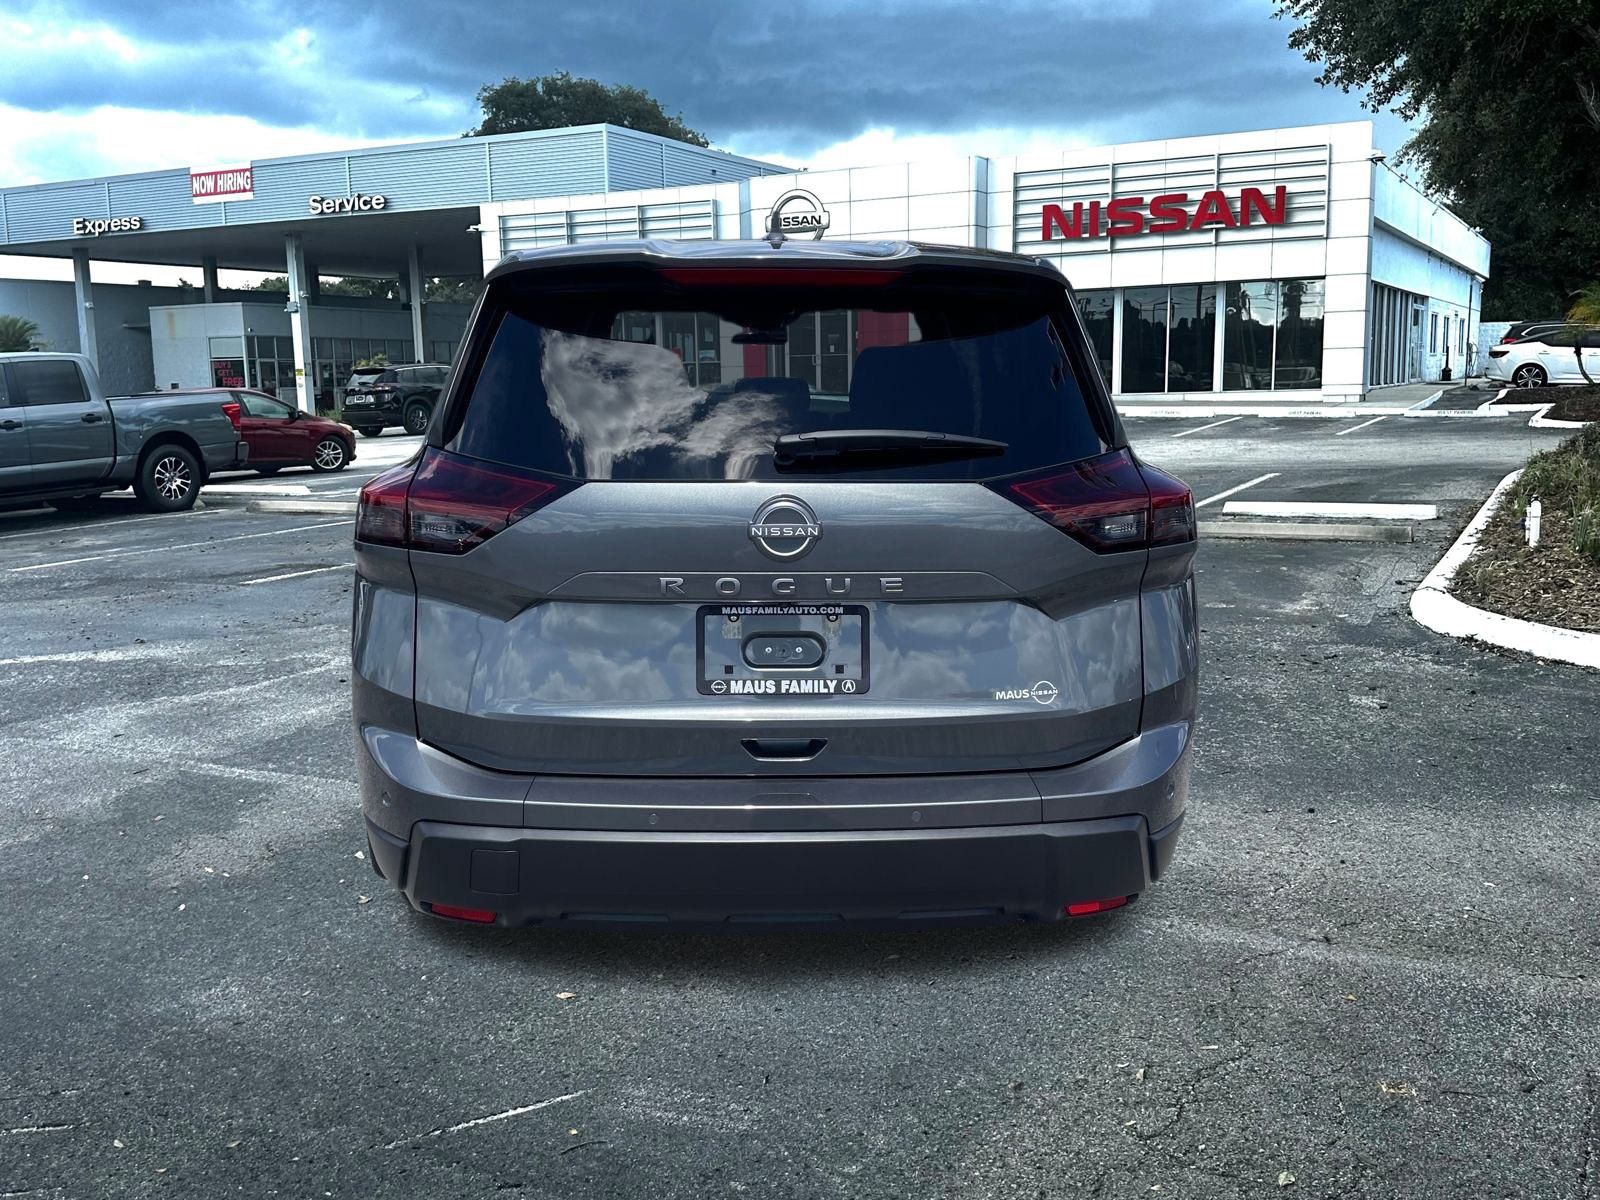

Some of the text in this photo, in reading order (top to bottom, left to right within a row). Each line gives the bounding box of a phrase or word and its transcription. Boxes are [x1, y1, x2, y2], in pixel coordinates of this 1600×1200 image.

[192, 171, 251, 195] NOW HIRING
[309, 193, 385, 215] Service
[1042, 185, 1287, 241] NISSAN
[73, 216, 141, 237] Express
[777, 215, 822, 228] ISSAN
[222, 377, 244, 387] FREE
[751, 526, 819, 536] NISSAN
[659, 577, 904, 595] ROGUE
[721, 606, 844, 615] MAUSFAMILYAUTO.COM
[730, 680, 838, 694] MAUS FAMILY
[995, 689, 1030, 700] MAUS
